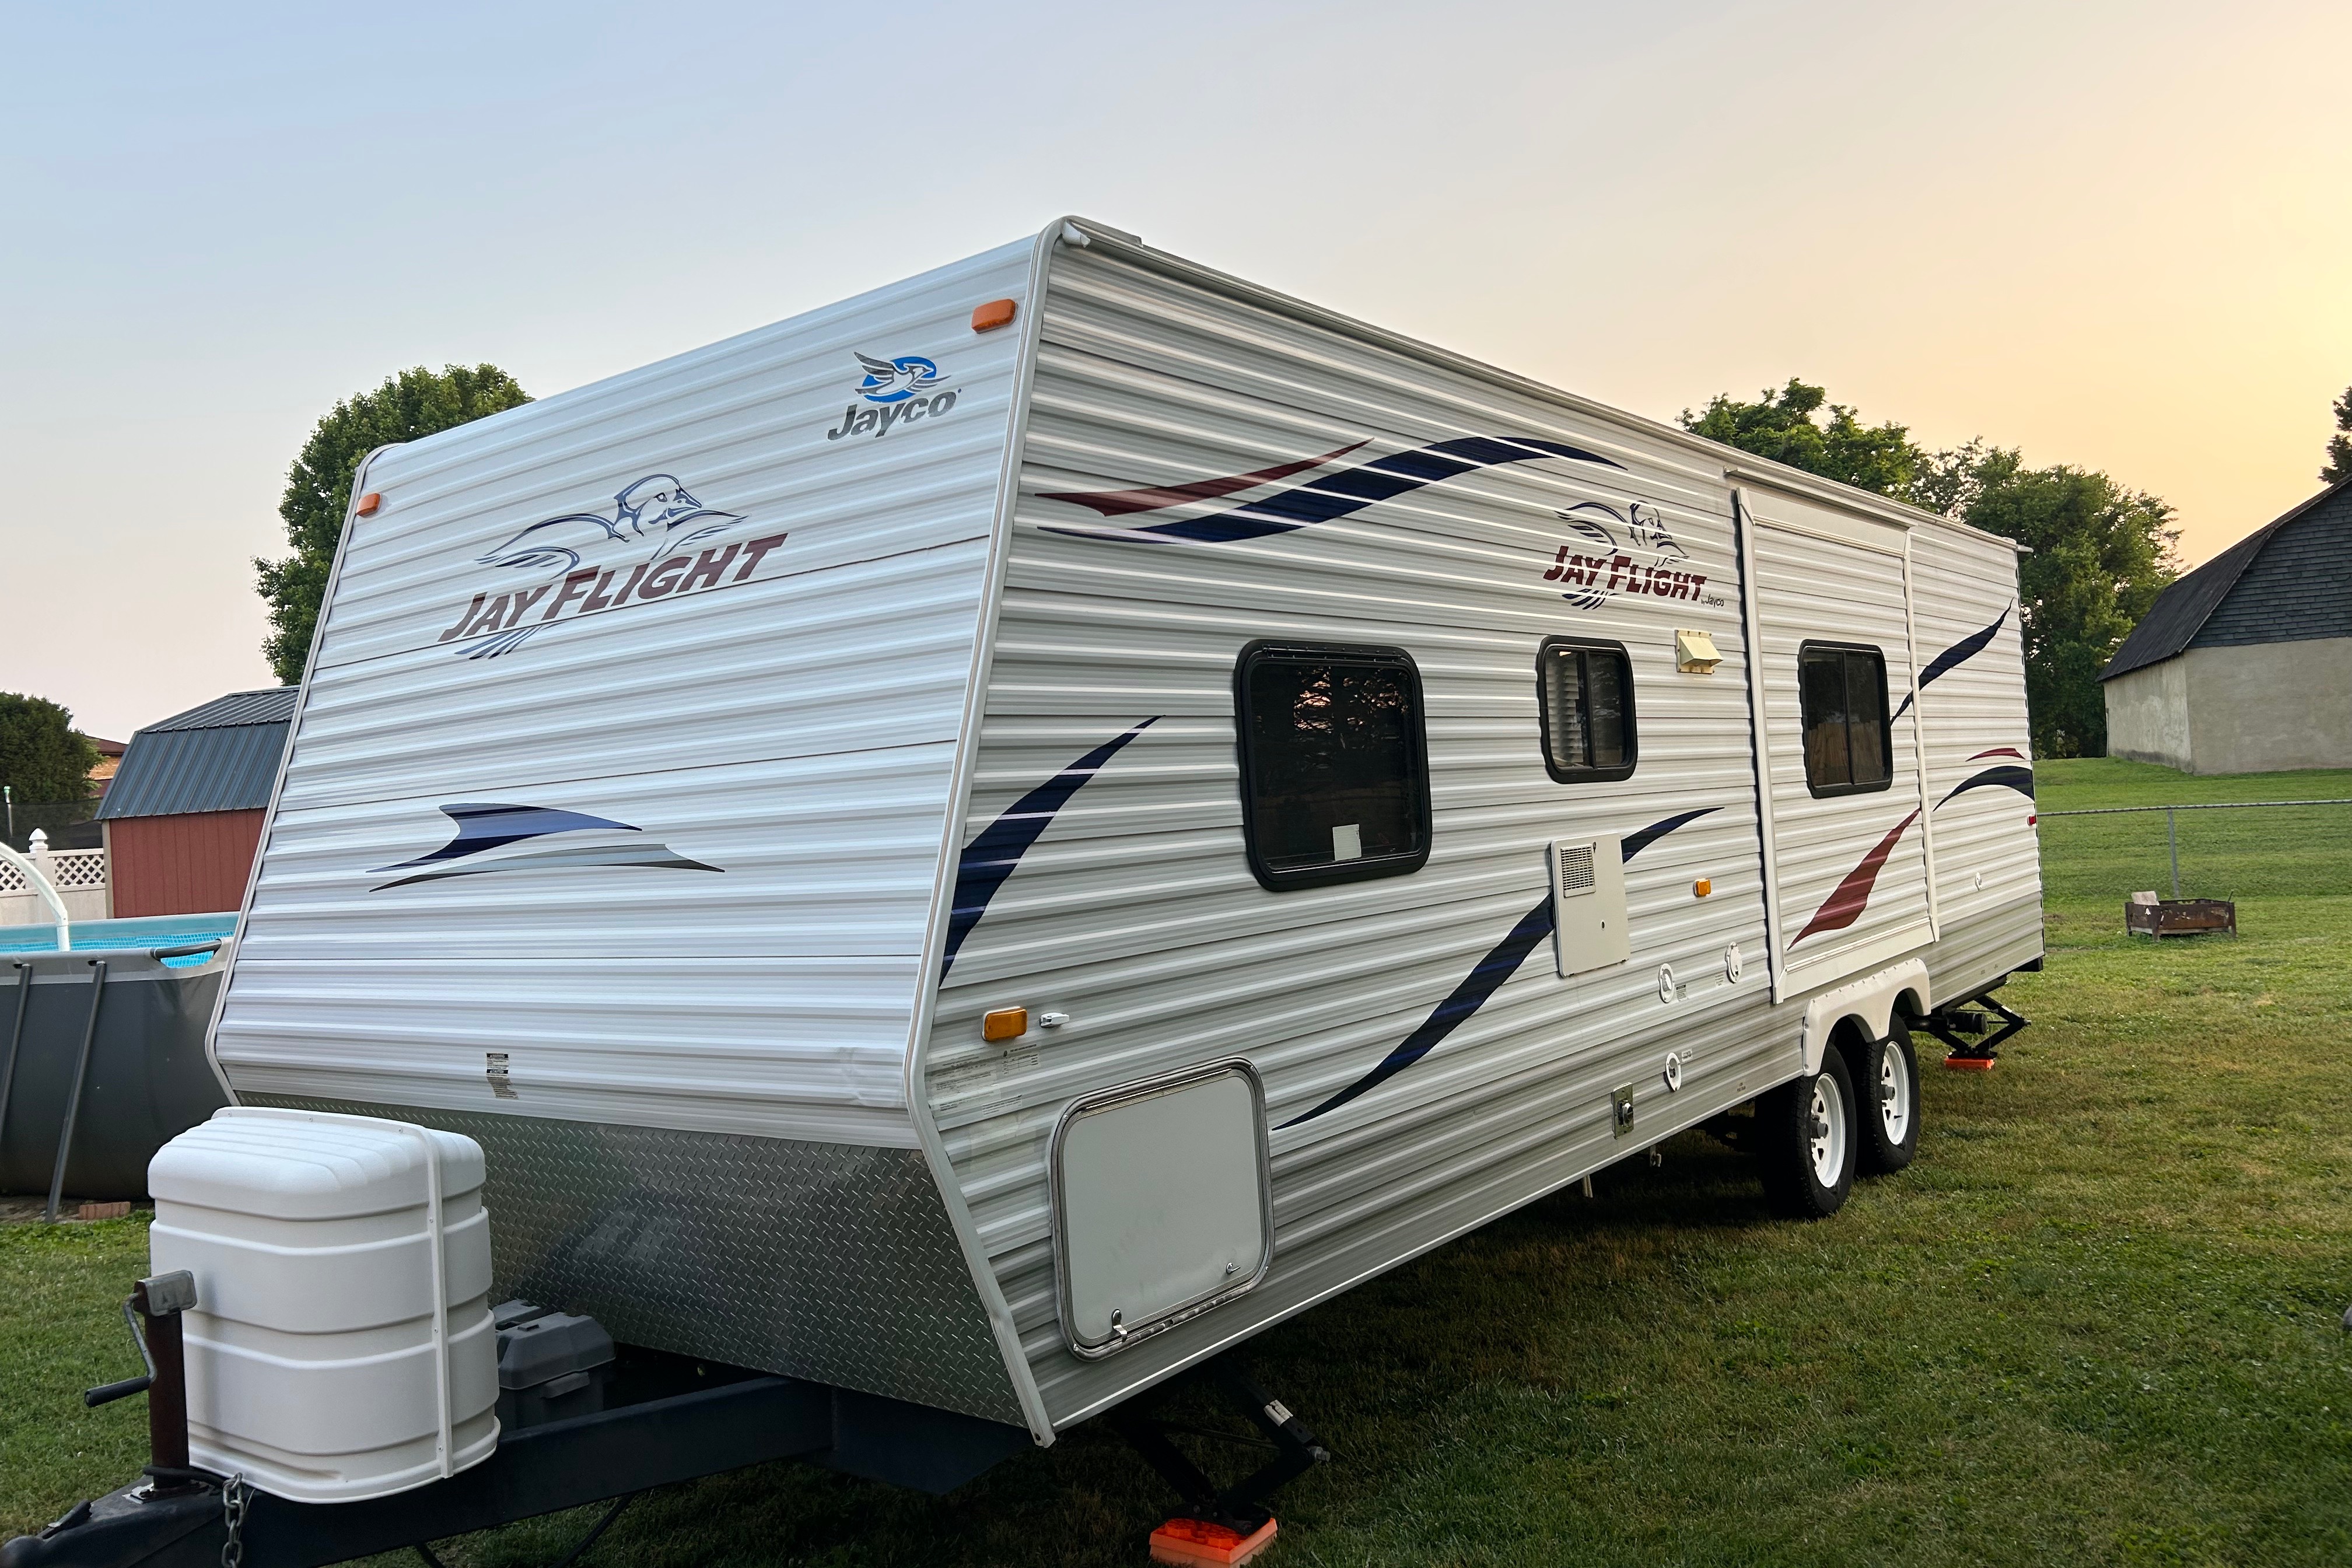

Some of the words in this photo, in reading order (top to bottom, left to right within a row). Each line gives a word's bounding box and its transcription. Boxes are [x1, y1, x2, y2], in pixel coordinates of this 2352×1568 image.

[827, 391, 957, 441] Jayco
[438, 584, 552, 642] JAY
[541, 533, 789, 621] FLIGHT
[1543, 545, 1607, 586] JAY
[1606, 555, 1707, 601] FLIGHT
[1705, 594, 1724, 608] Jayco
